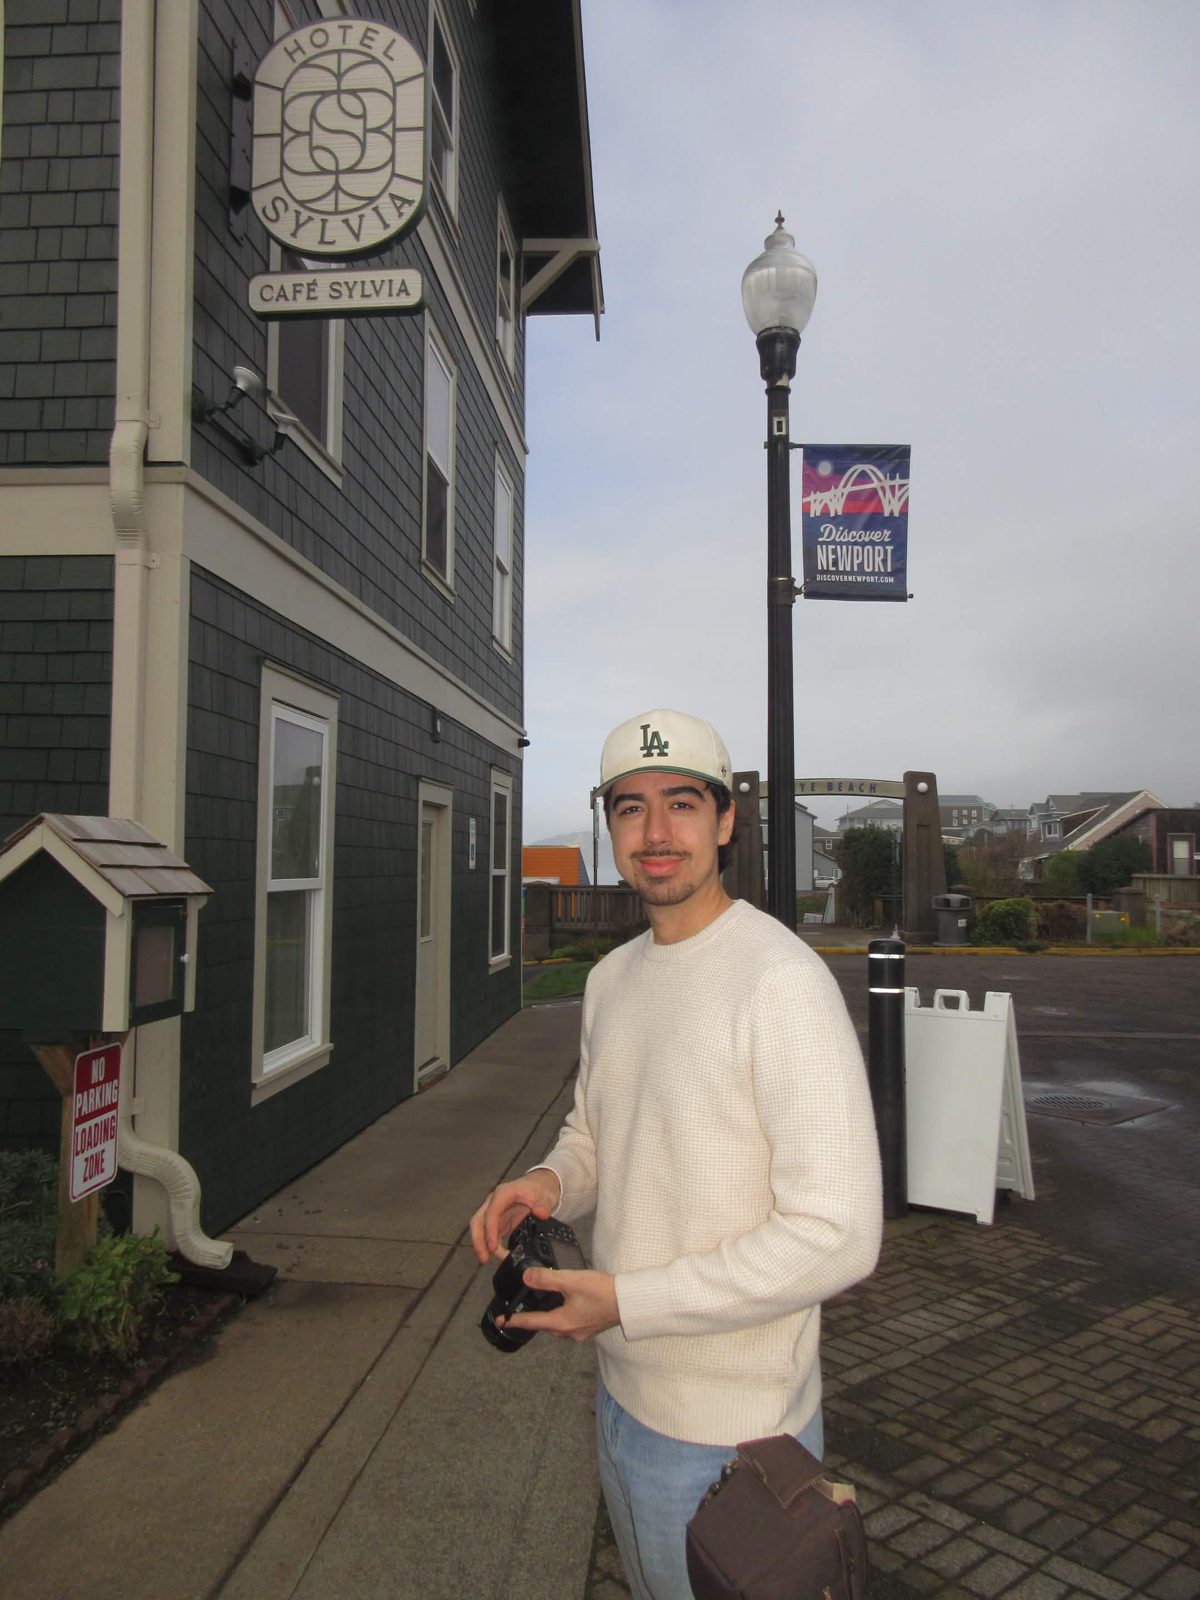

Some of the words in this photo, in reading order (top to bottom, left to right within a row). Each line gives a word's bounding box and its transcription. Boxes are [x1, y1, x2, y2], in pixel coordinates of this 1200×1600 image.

[283, 24, 398, 63] HOTEL
[262, 191, 415, 245] SYLVIA
[259, 278, 319, 302] CAFÉ
[328, 278, 411, 300] SYLVIA
[818, 523, 892, 543] Discover
[816, 545, 894, 572] NEWPORT
[816, 574, 894, 584] DISCOVERNEWPORT.COM
[639, 723, 670, 758] LA
[800, 782, 816, 793] YE
[827, 781, 877, 794] BEACH
[92, 1057, 105, 1083] NO
[76, 1080, 118, 1118] PARKING
[75, 1116, 116, 1156] LOADING
[83, 1149, 105, 1182] ZONE
